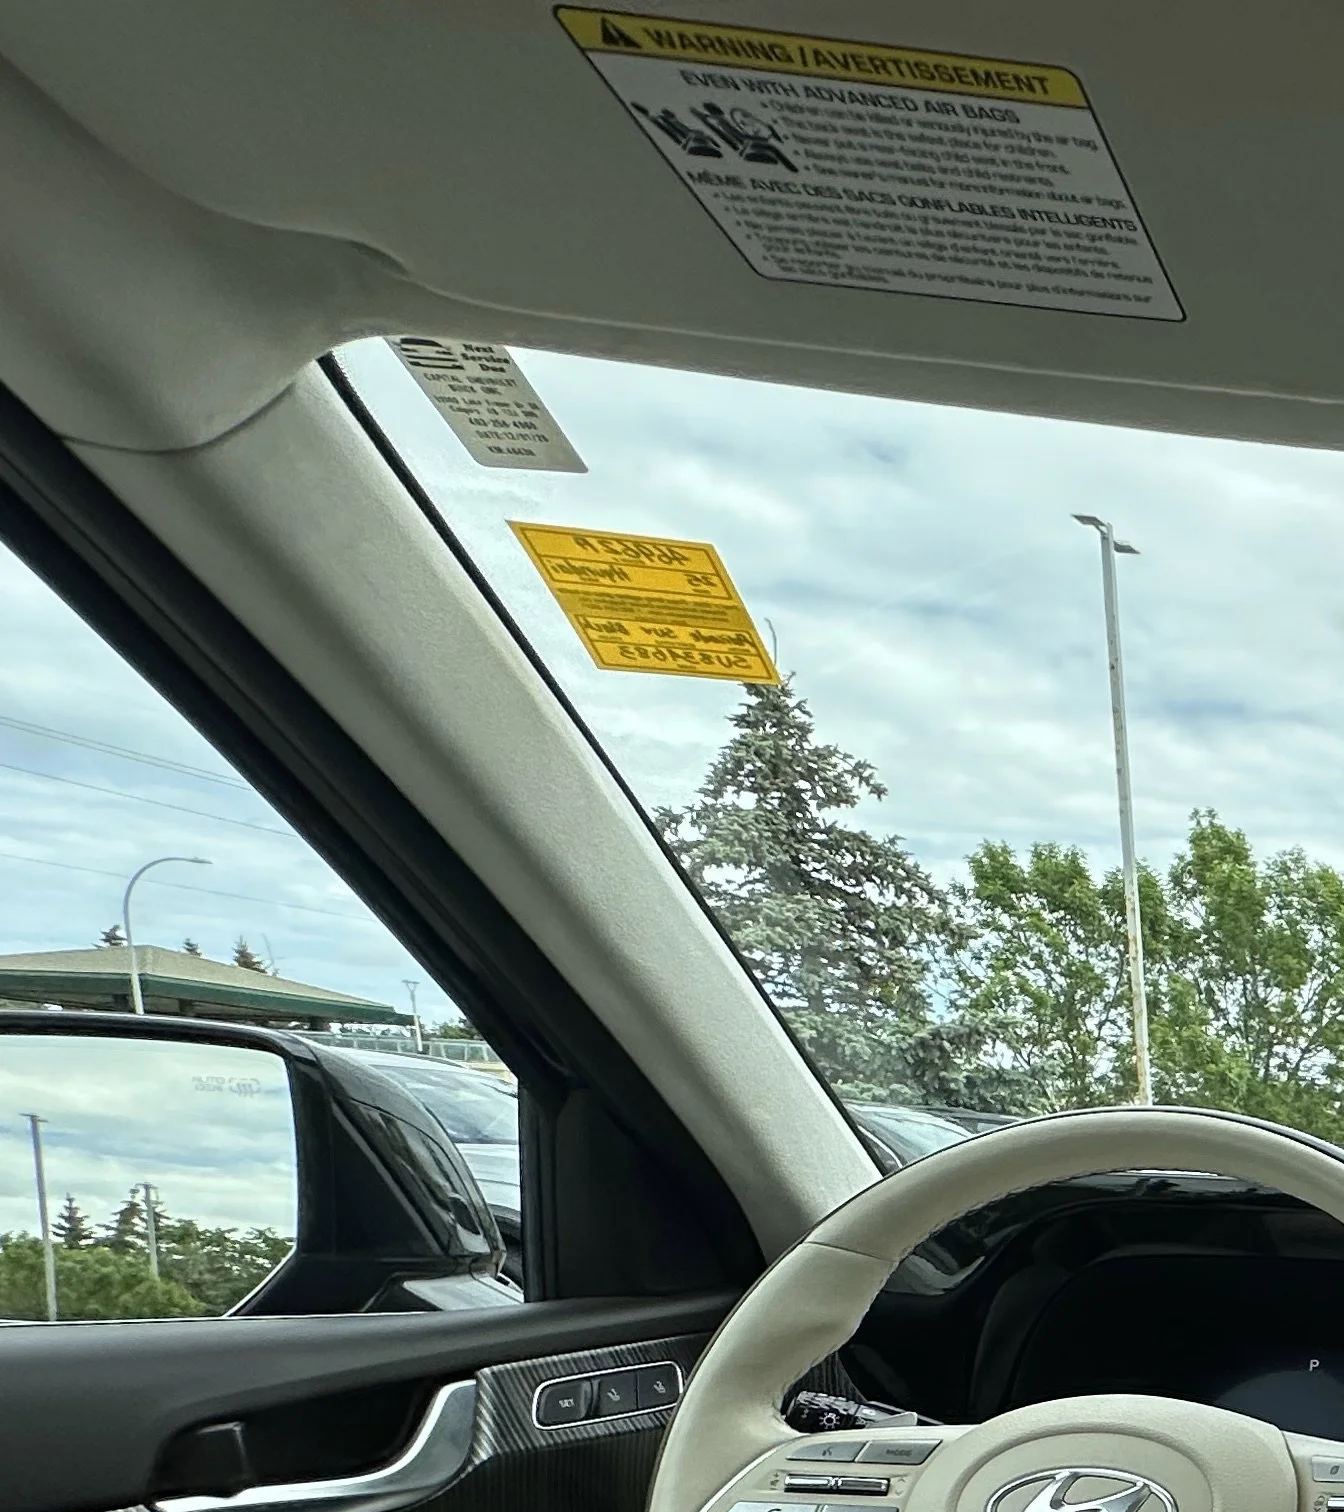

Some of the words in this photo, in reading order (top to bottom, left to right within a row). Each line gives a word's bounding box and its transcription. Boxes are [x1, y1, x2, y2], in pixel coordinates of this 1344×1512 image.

[679, 70, 740, 91] EVEN
[740, 77, 800, 98] WITH
[803, 85, 918, 112] ADVANCED
[924, 100, 958, 117] AIR
[961, 104, 1020, 123] BAGS
[750, 177, 802, 195] AVEC
[802, 183, 843, 200] DES
[843, 187, 897, 205] SACS
[1017, 208, 1137, 232] INTELLIGENTS
[462, 343, 494, 354] Next
[460, 352, 511, 365] Service
[479, 363, 506, 373] Due
[1309, 1359, 1320, 1372] P
